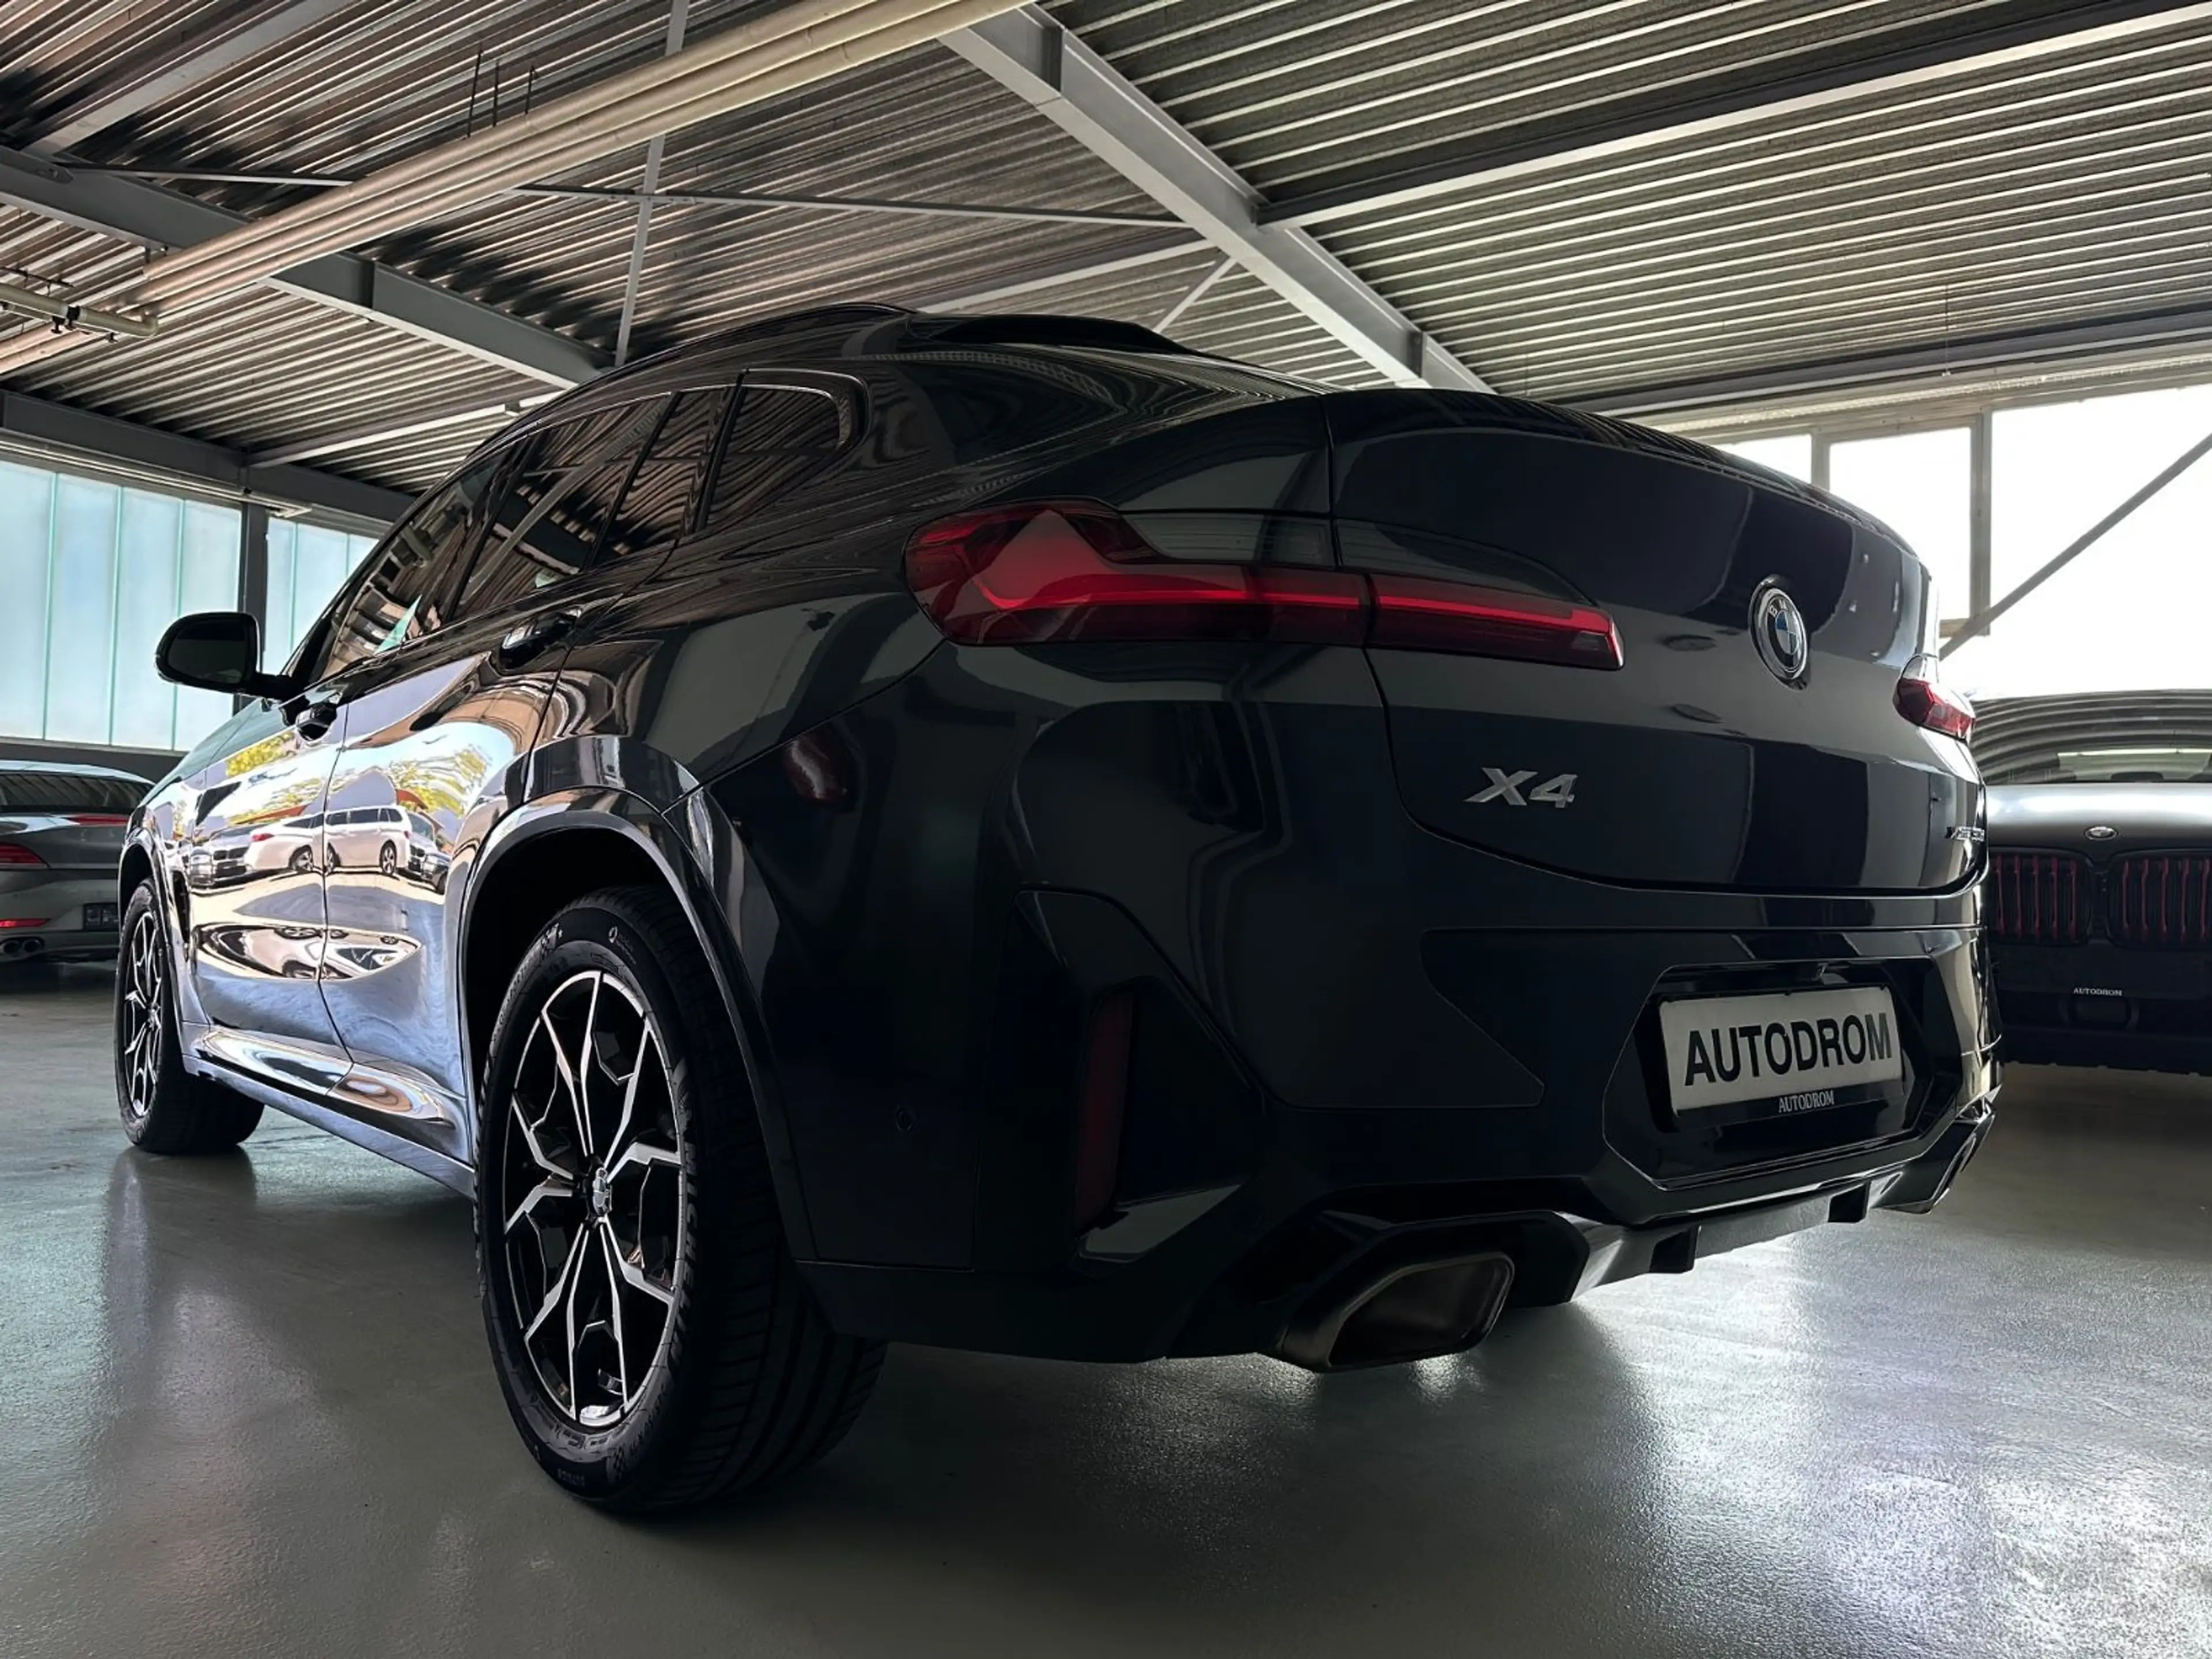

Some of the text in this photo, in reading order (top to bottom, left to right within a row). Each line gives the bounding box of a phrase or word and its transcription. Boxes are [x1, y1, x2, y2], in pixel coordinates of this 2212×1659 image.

[1463, 768, 1578, 808] X4
[2073, 987, 2123, 997] AUTODROM
[1685, 1013, 1892, 1086] AUTODROM
[1779, 1091, 1834, 1113] AUTODROM
